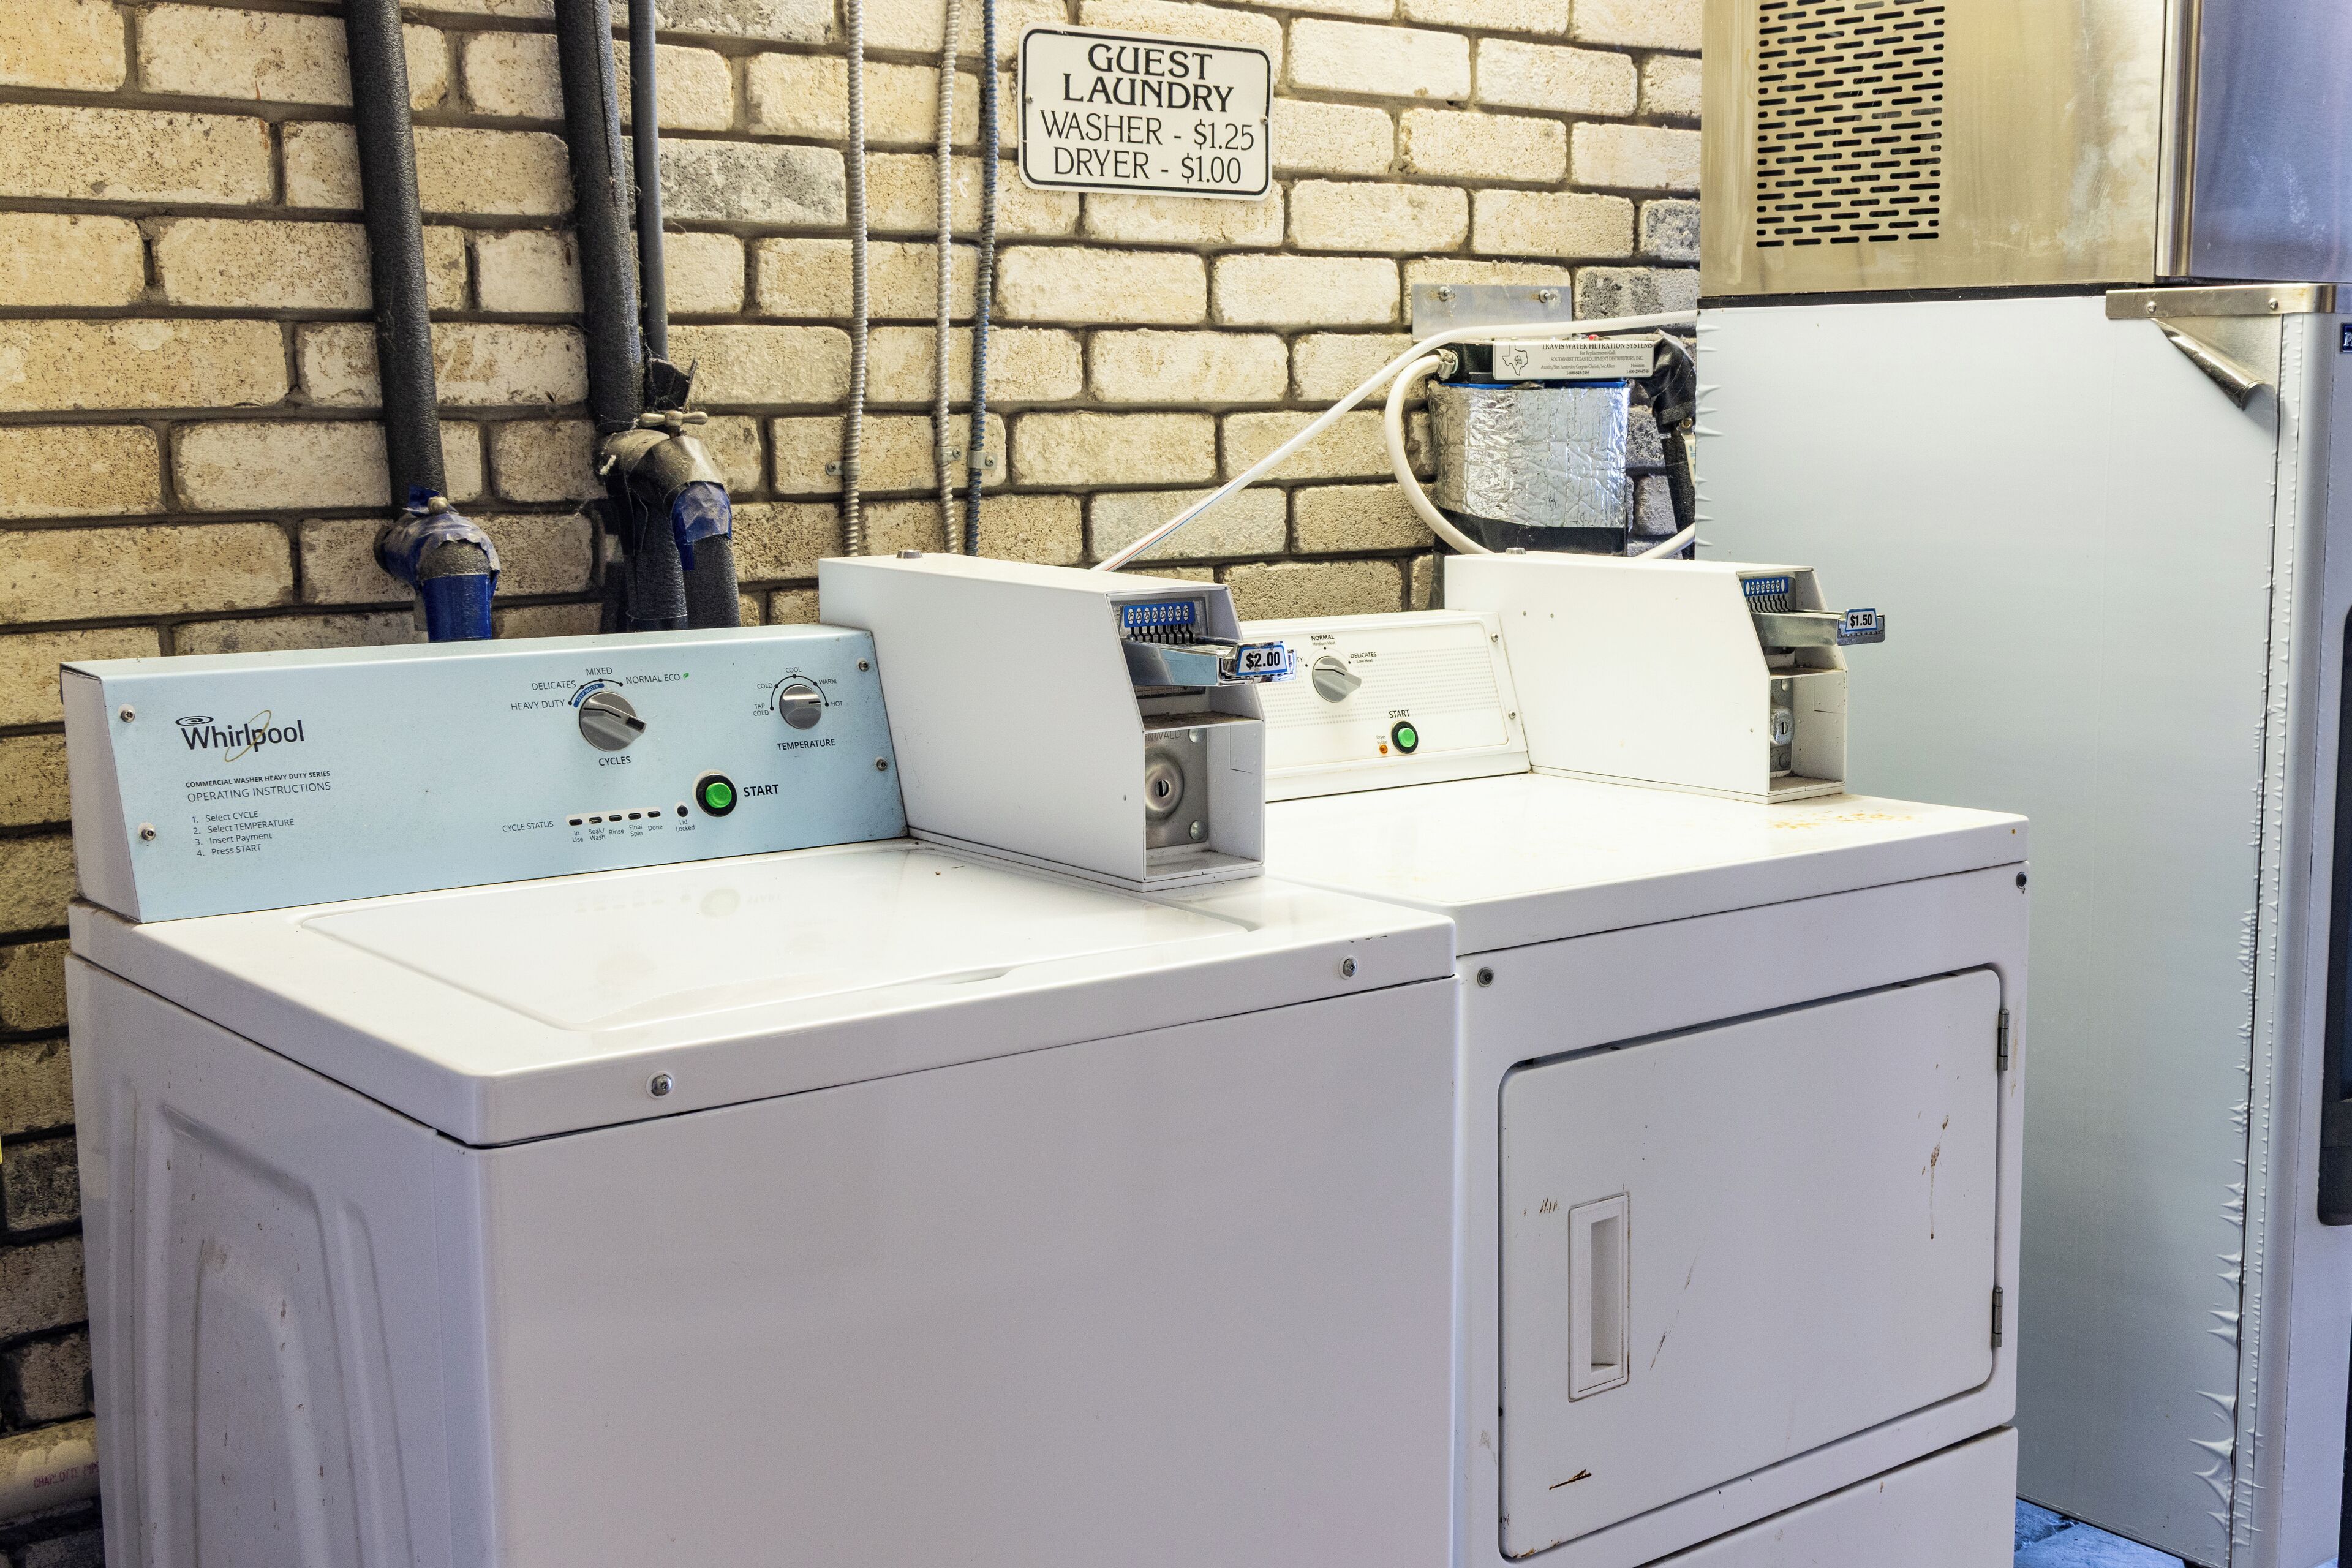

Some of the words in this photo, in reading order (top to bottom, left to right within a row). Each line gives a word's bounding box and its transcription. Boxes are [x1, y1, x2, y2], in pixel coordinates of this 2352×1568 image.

[1088, 43, 1212, 80] GUEST
[1063, 73, 1234, 113] LAUNDRY
[1040, 110, 1163, 145] WASHER
[1194, 119, 1254, 151] $1.25
[1054, 146, 1150, 179] DRYER
[1181, 153, 1241, 184] $1.00
[2343, 332, 2352, 347] P
[1850, 614, 1872, 628] $1.50
[1246, 652, 1280, 670] $2.00
[586, 667, 612, 676] MIXED
[626, 675, 662, 684] NORMAL
[665, 673, 680, 682] ECO
[532, 680, 576, 691] DELICATES
[576, 692, 585, 702] DEEP
[585, 684, 598, 693] WATER
[511, 702, 539, 710] HEAVY
[541, 699, 565, 709] DUTY
[1389, 709, 1409, 718] START
[181, 720, 304, 752] Whirlpool
[1145, 730, 1181, 741] NWALD
[777, 739, 836, 750] TEMPERATURE
[598, 756, 631, 767] CYCLES
[186, 778, 232, 788] COMMERCIAL
[234, 775, 263, 784] WASHER
[187, 788, 250, 802] OPERATING
[253, 782, 331, 796] INSTRUCTIONS
[743, 784, 780, 797] START
[206, 813, 230, 822] Select
[233, 810, 258, 820] CYCLE
[207, 824, 233, 834] Select
[234, 818, 295, 831] TEMPERATURE
[502, 823, 525, 832] CYCLE
[527, 821, 554, 830] STATUS
[209, 836, 234, 845] Insert
[236, 832, 273, 843] Payment
[236, 844, 261, 853] START
